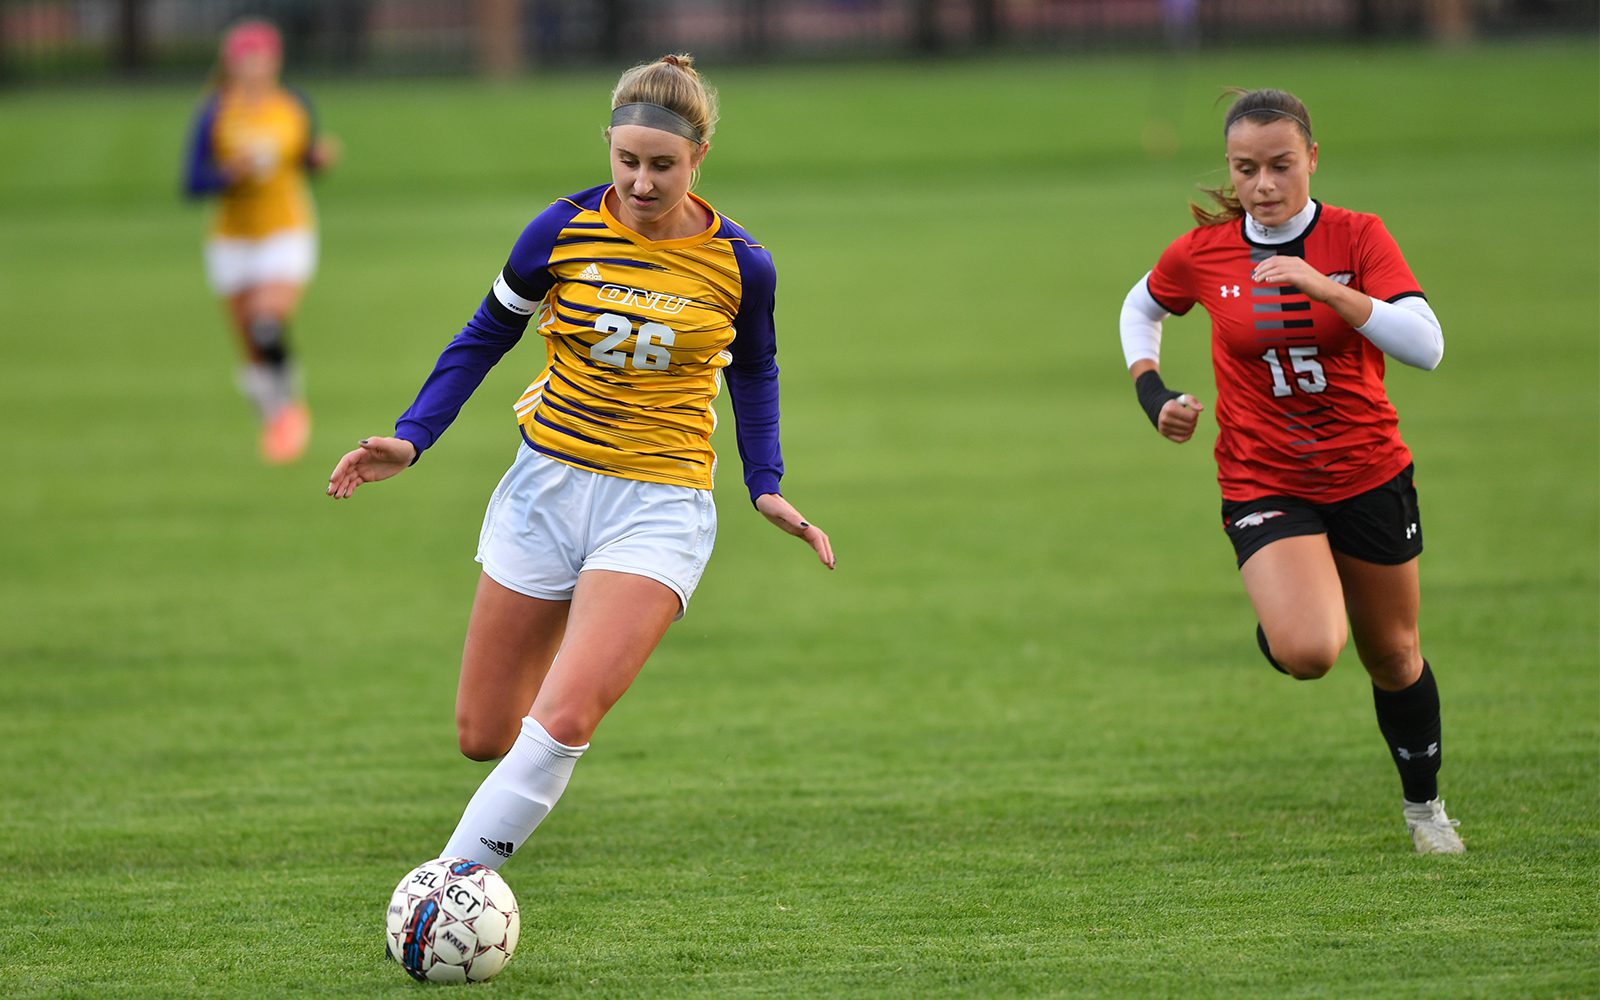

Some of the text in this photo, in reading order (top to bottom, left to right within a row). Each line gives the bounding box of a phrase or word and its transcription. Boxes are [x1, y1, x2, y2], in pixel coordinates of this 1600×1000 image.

[597, 284, 692, 314] ONU
[590, 313, 676, 371] 26
[1261, 345, 1327, 397] 15
